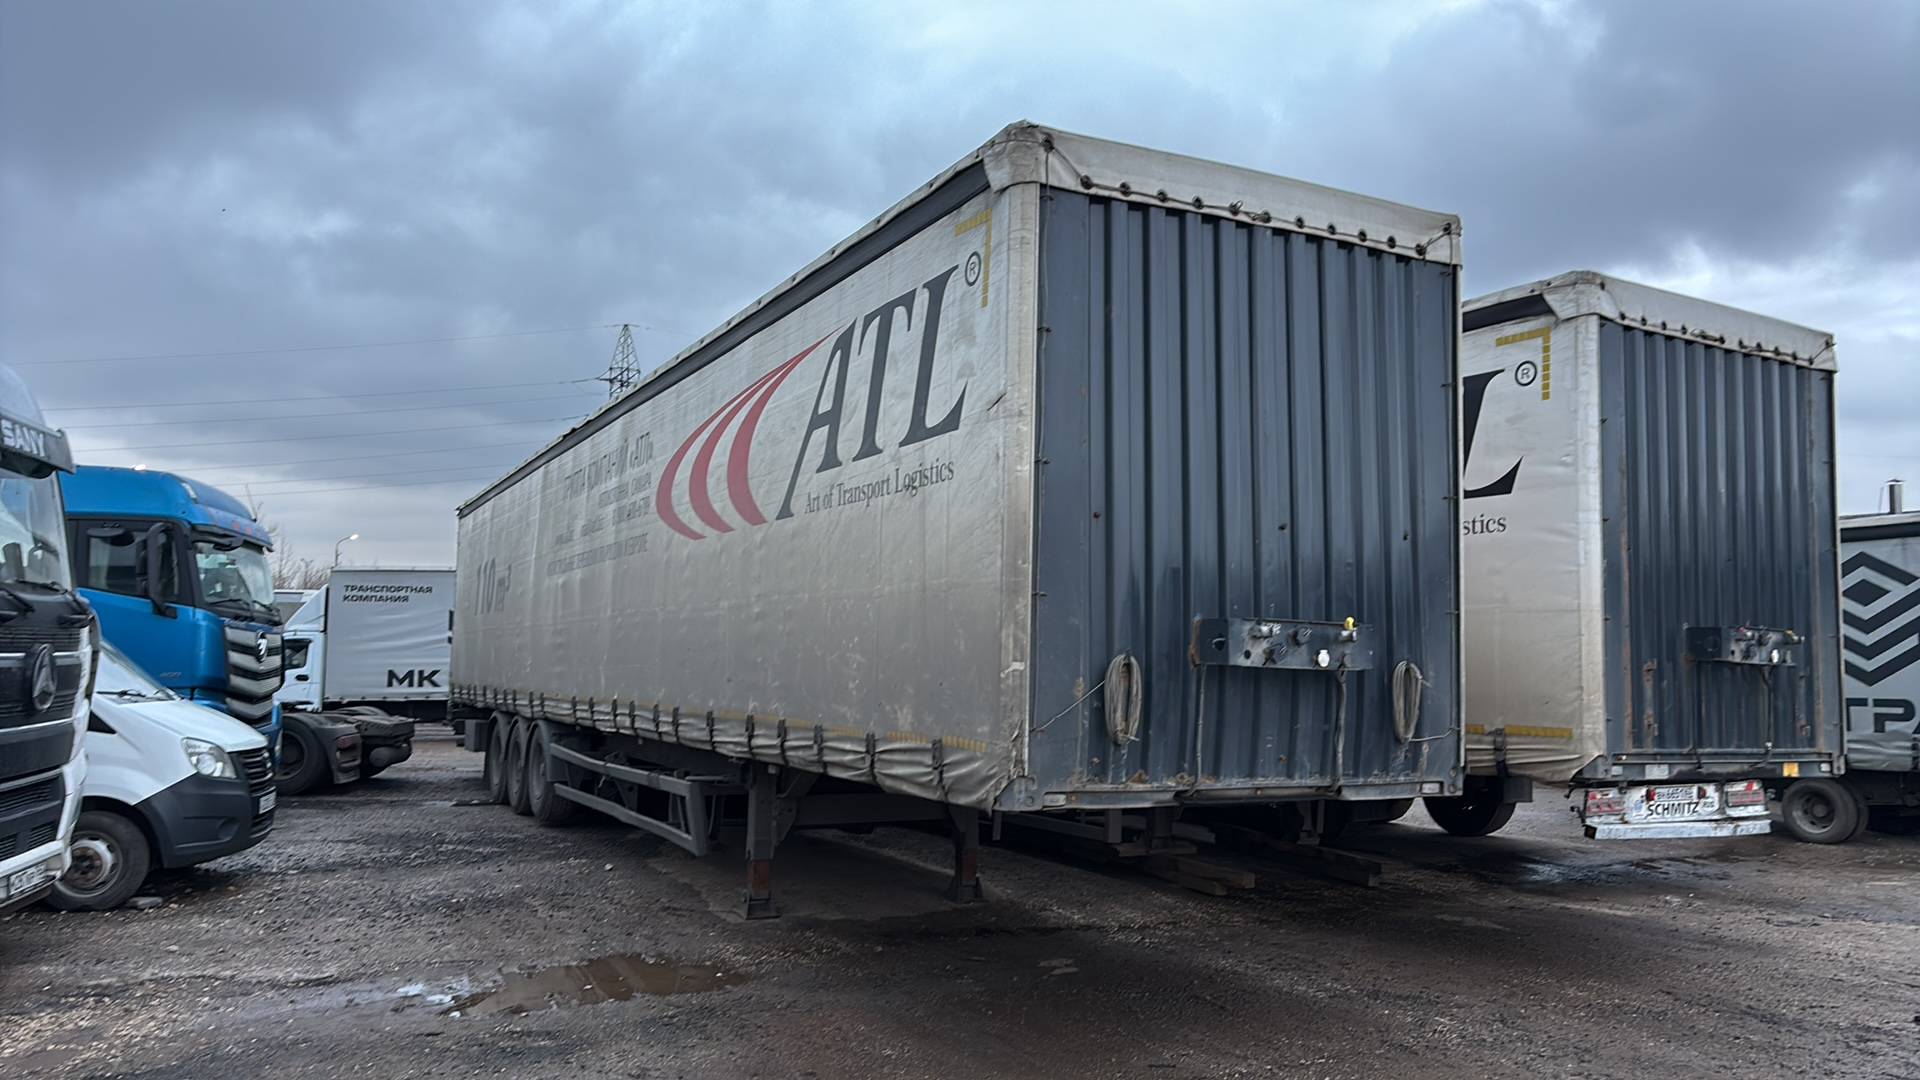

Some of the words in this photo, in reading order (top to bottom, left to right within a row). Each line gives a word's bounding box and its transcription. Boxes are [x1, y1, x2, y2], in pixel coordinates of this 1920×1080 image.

[775, 264, 968, 521] ATL
[1, 419, 46, 457] SANY
[805, 491, 821, 514] Art
[823, 483, 834, 508] of
[836, 474, 891, 507] Transport
[895, 457, 955, 497] Logistics
[342, 594, 410, 603] КОМПАНИЯ
[343, 584, 433, 594] ТРАНСПОРТНАЯ
[1647, 801, 1700, 817] SCHMITZ
